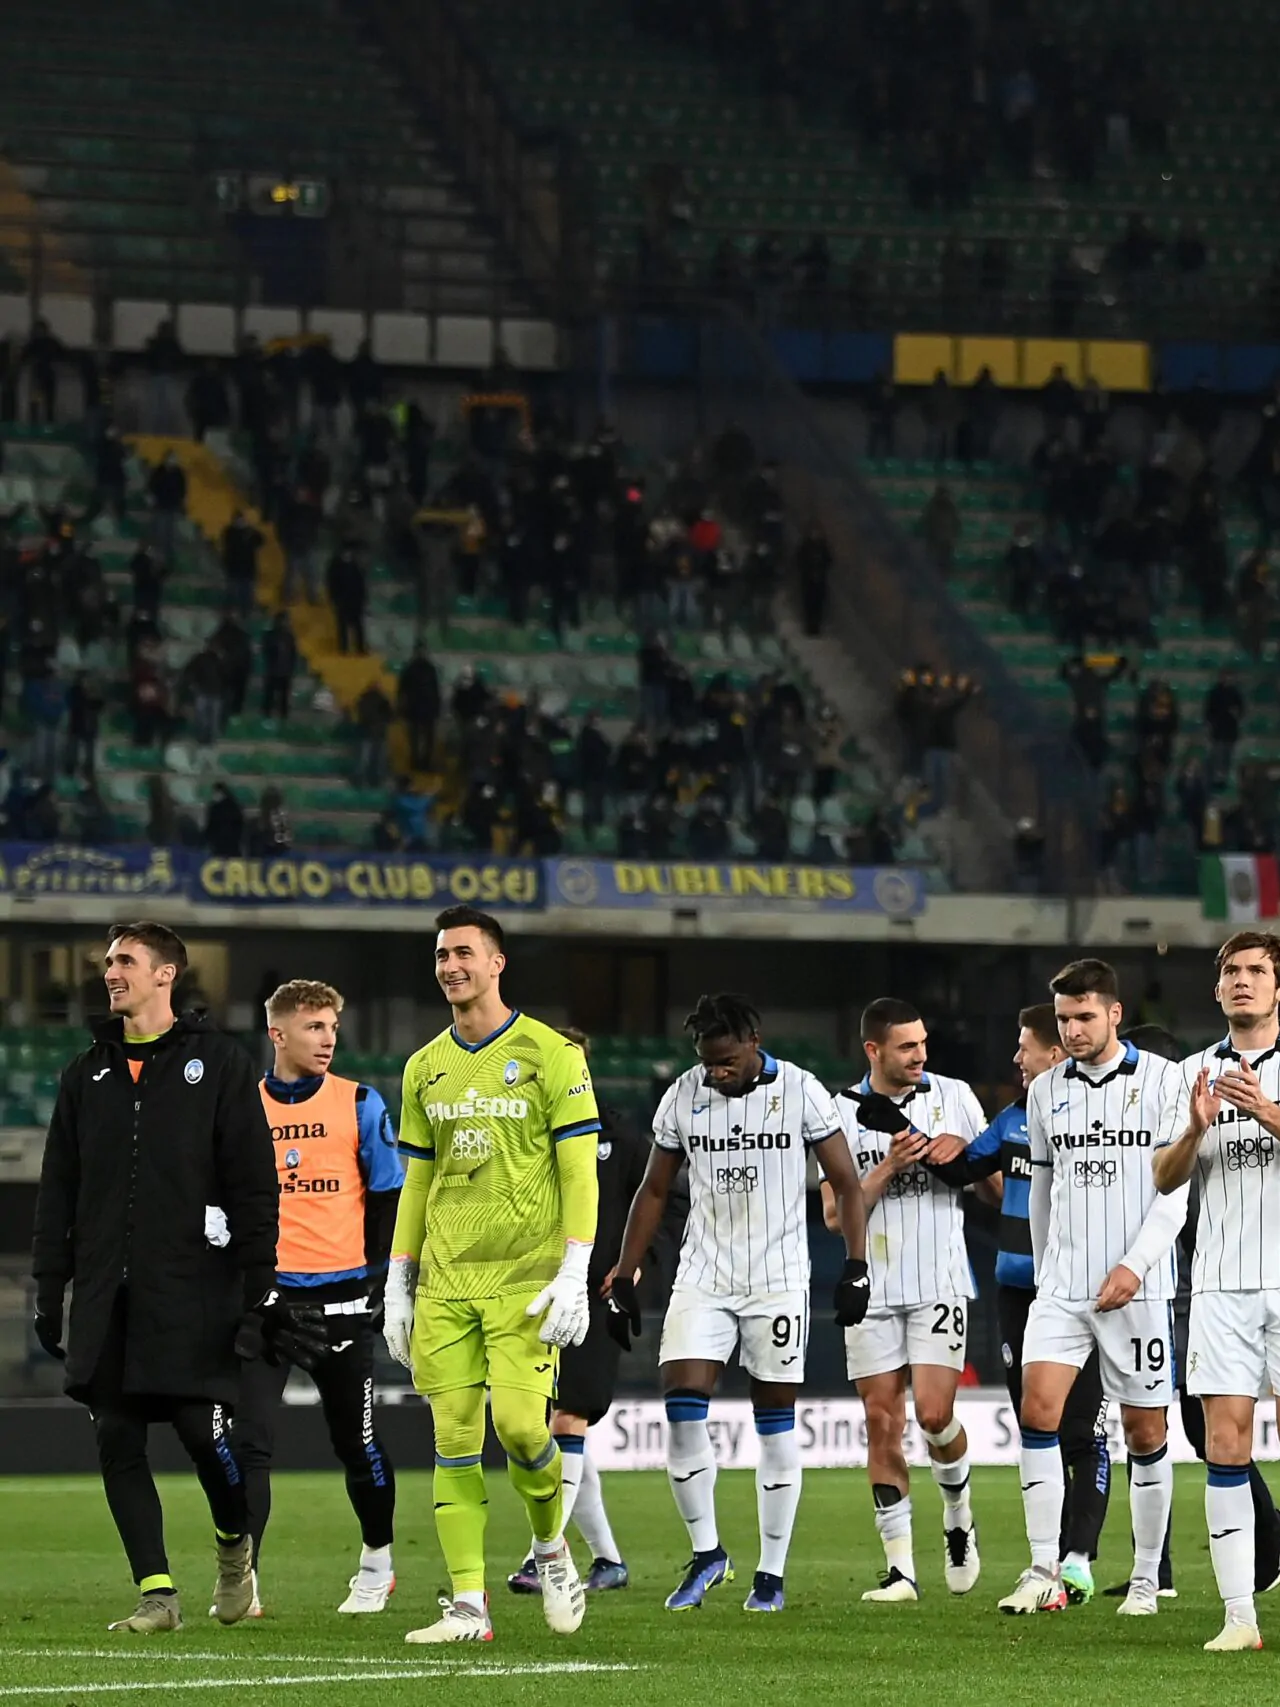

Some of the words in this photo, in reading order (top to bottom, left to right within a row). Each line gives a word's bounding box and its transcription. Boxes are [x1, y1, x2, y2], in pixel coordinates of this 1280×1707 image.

[202, 858, 332, 897] CALCIO
[346, 860, 436, 899] CLUB
[614, 861, 855, 898] DUBLINERS
[425, 1097, 528, 1122] Plus500
[270, 1122, 328, 1142] oma
[1051, 1130, 1150, 1152] Plus500
[688, 1133, 791, 1153] Plus500
[1227, 1137, 1274, 1157] RADICI
[1075, 1160, 1116, 1176] RADICI
[1228, 1153, 1274, 1171] GROUP
[717, 1166, 758, 1182] RADICI
[1074, 1174, 1117, 1188] GROUP
[716, 1180, 758, 1195] GROUP
[931, 1303, 964, 1338] 28
[772, 1315, 801, 1348] 91
[1130, 1337, 1165, 1373] 19
[613, 1407, 744, 1462] Singy
